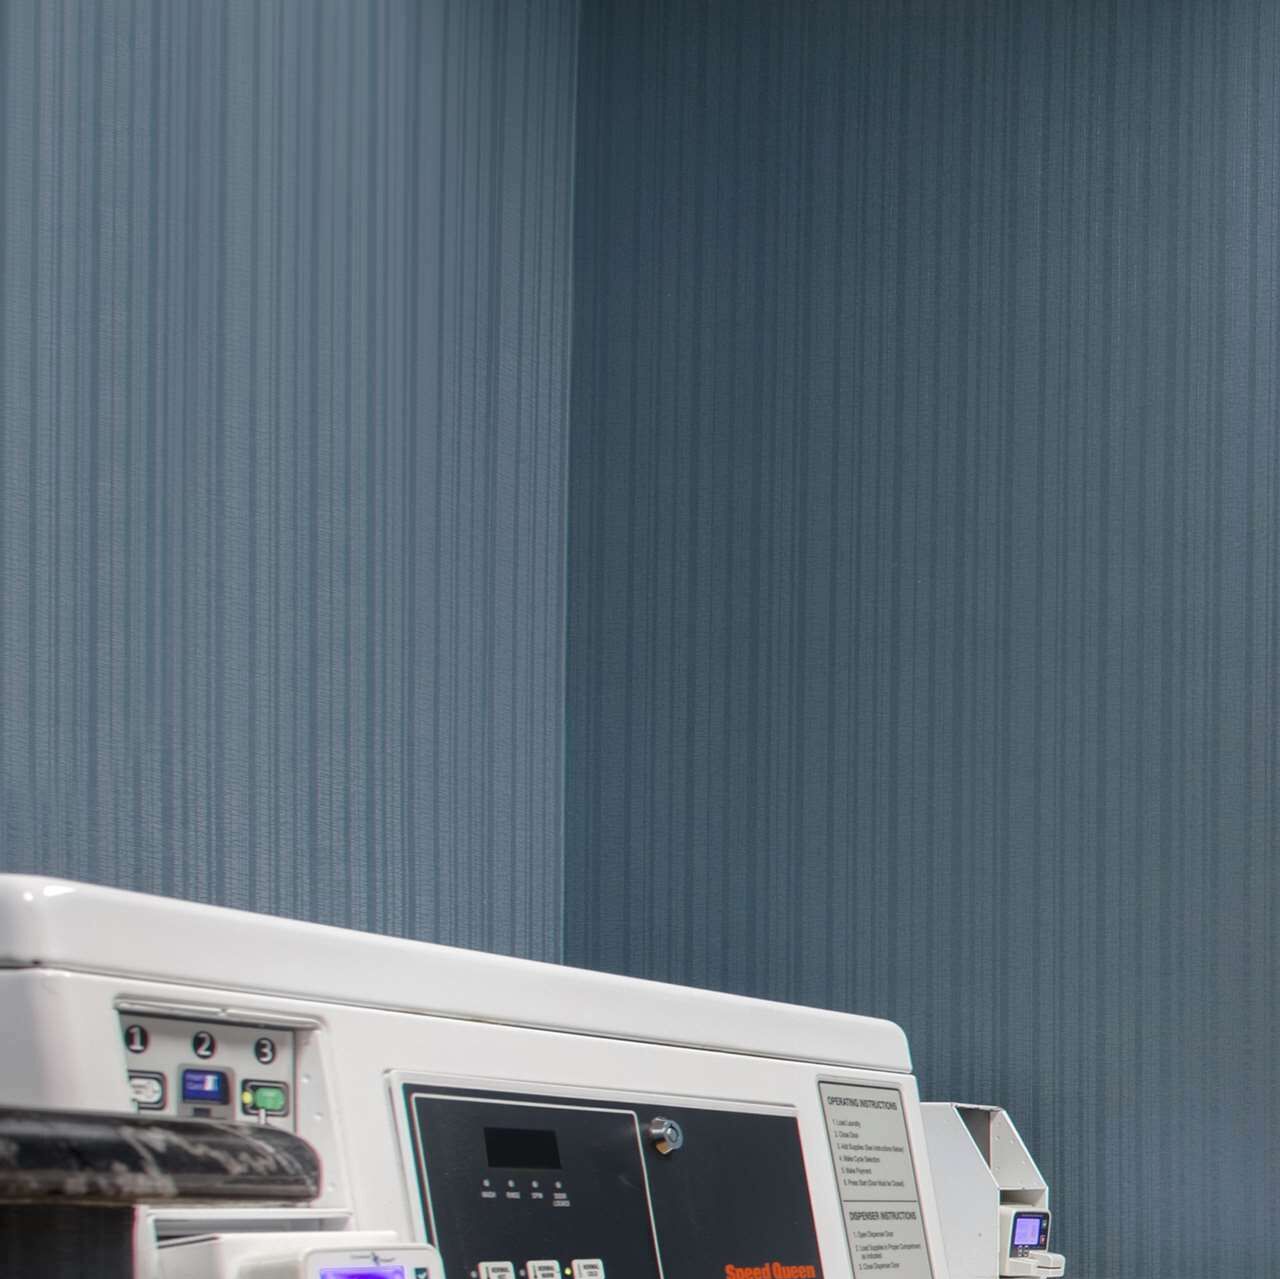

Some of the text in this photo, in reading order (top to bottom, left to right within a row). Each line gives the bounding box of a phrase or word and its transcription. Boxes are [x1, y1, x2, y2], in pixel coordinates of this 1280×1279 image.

[129, 1026, 144, 1051] 1
[196, 1032, 212, 1056] 2
[259, 1039, 273, 1063] 3
[827, 1096, 898, 1110] OPERATING INSTRUCTIONS
[849, 1211, 917, 1221] DISPENSER INSTRUCTIONS
[772, 1261, 816, 1279] Queen
